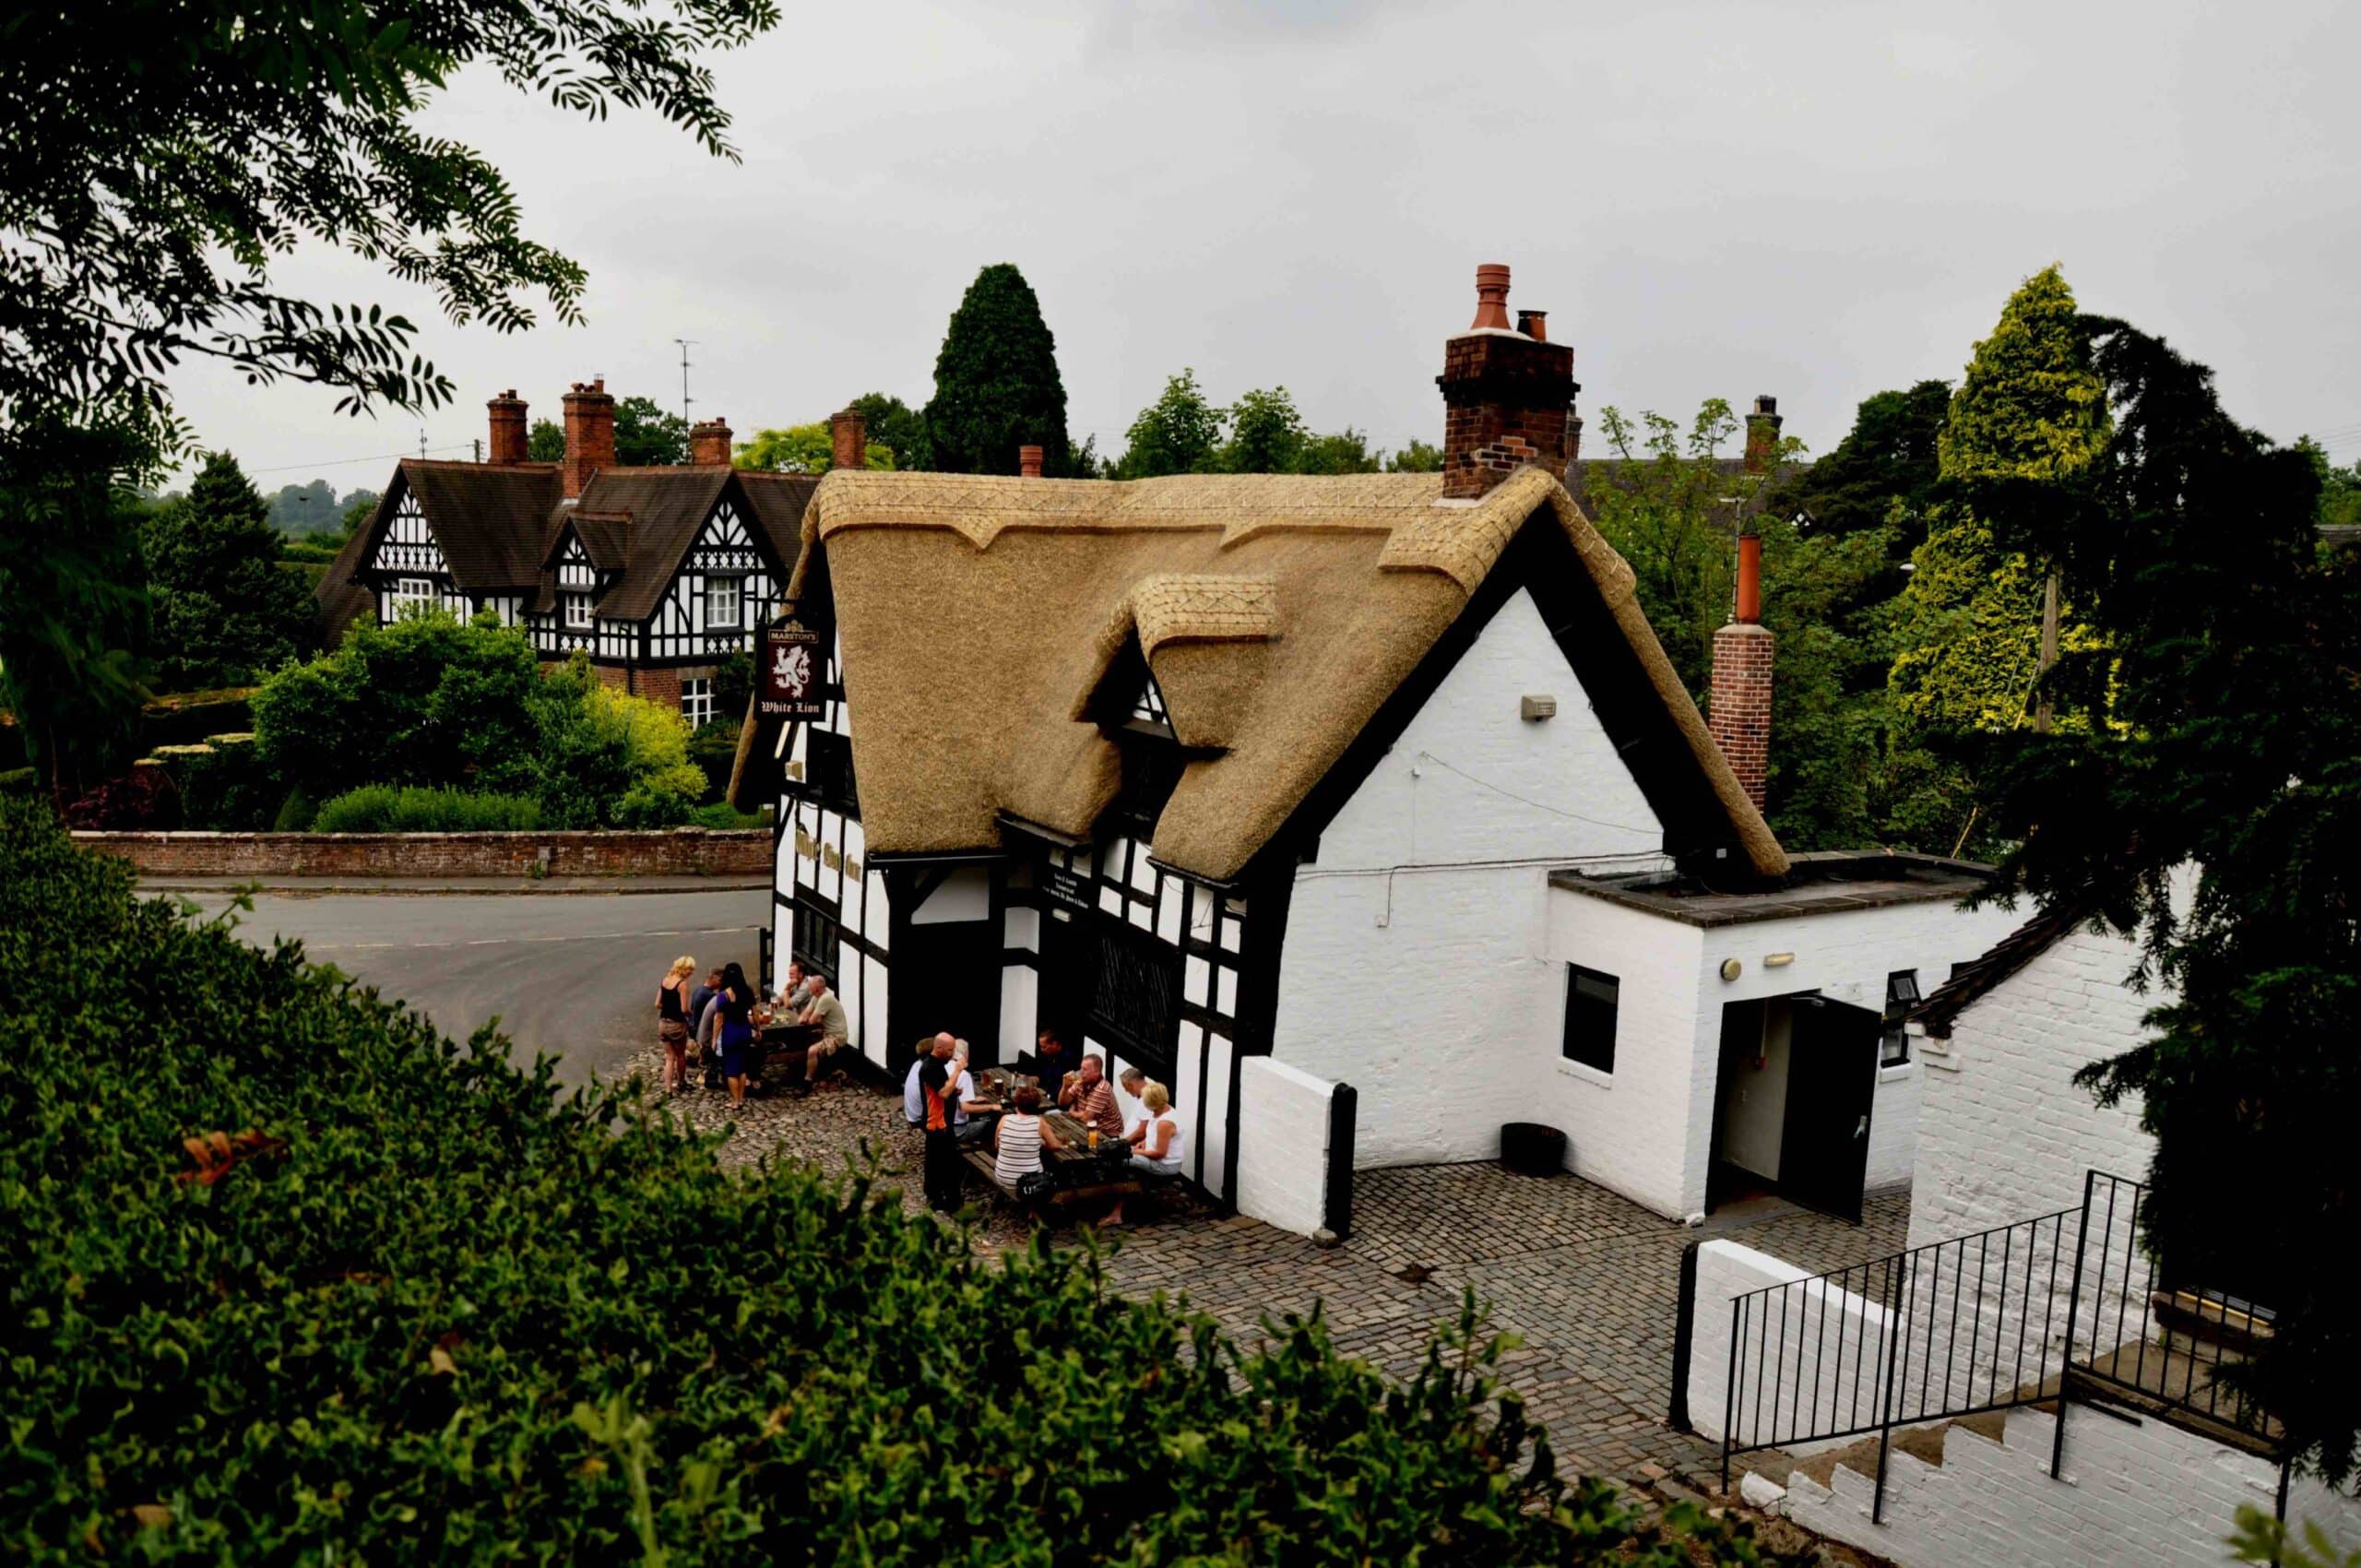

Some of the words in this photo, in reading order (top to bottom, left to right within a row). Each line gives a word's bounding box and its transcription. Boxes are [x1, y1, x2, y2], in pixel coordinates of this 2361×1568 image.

[771, 632, 816, 641] MARSTON'S
[761, 701, 792, 714] White
[796, 702, 820, 713] Lion
